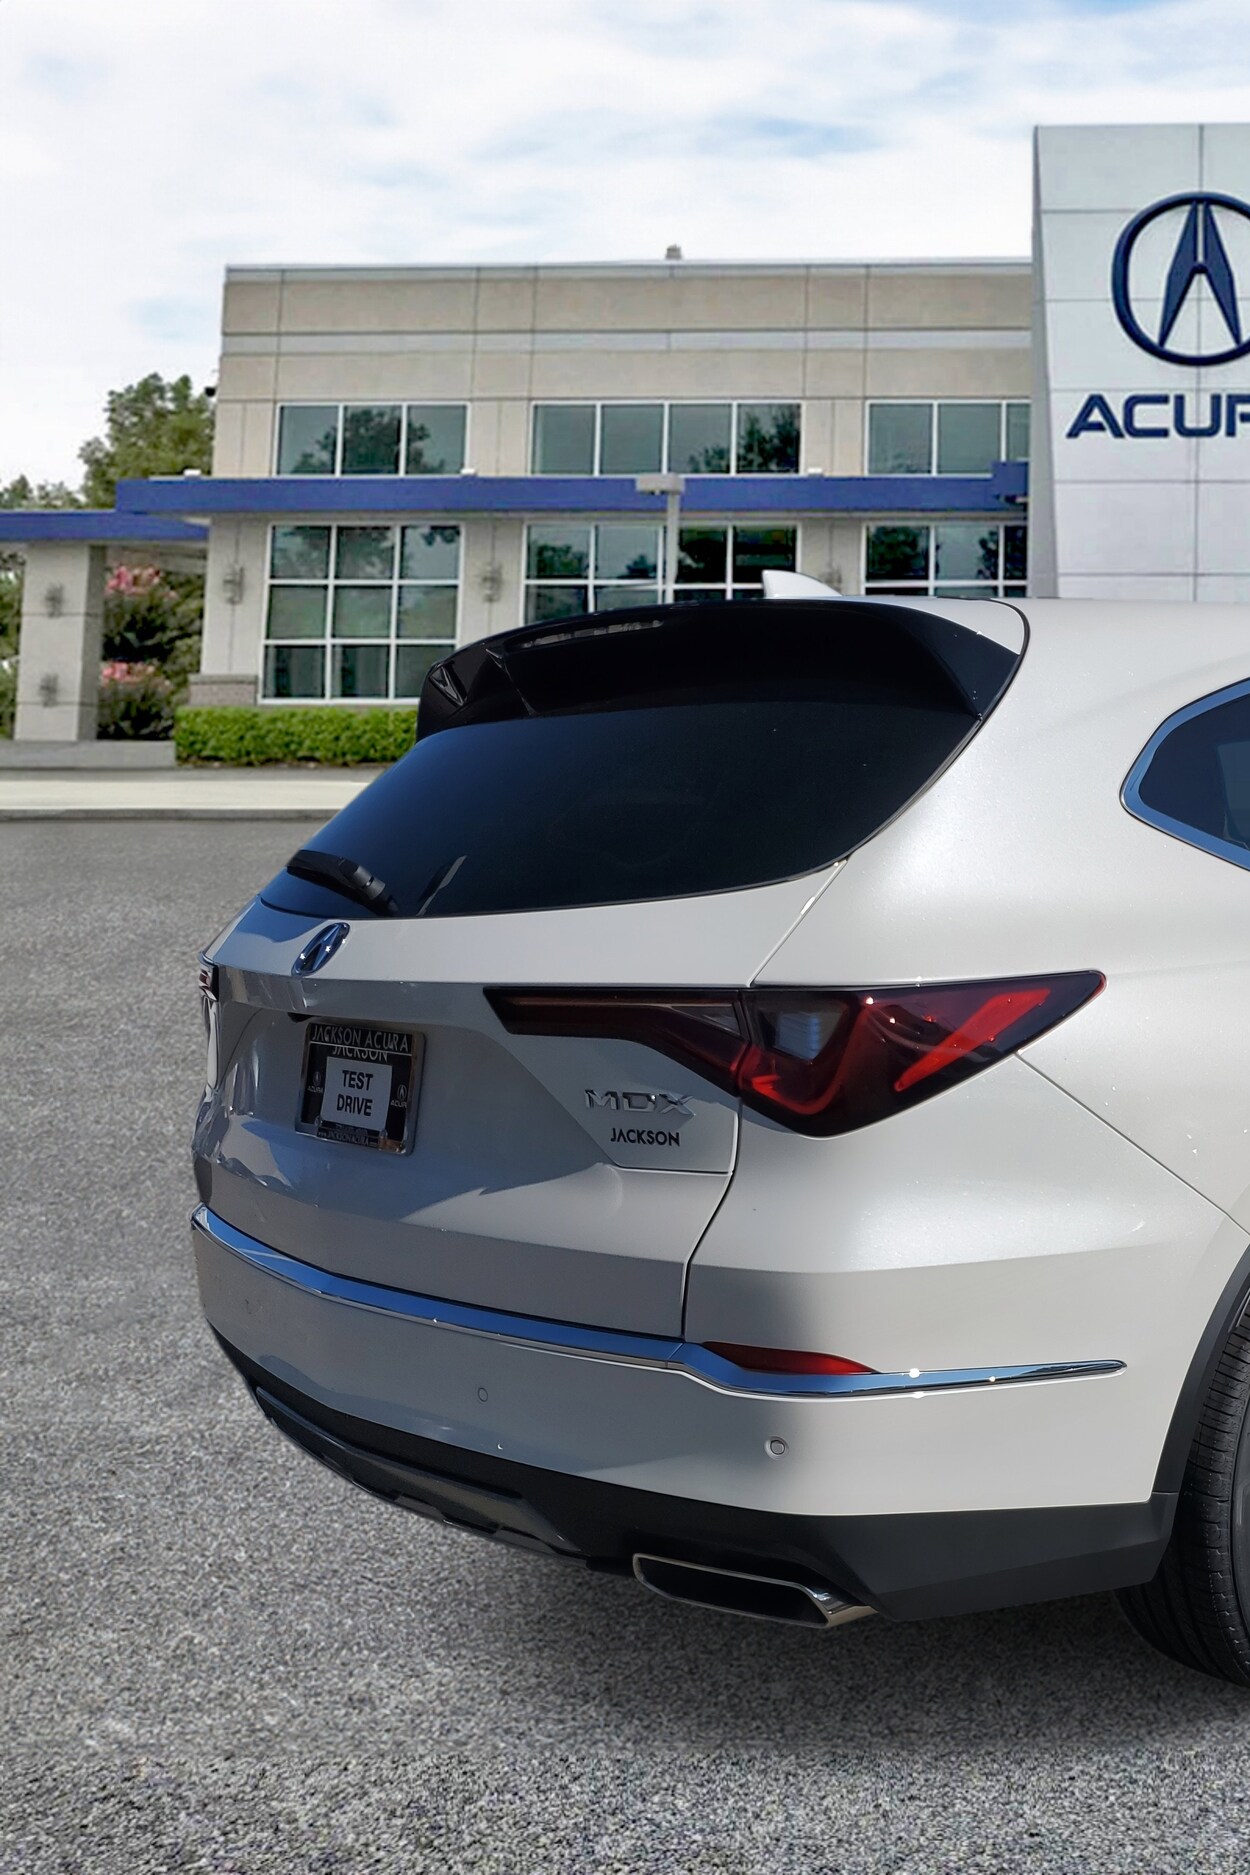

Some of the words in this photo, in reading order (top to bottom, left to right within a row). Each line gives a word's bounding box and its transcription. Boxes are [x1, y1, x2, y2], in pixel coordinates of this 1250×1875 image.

[312, 1025, 361, 1046] JACKSON
[364, 1031, 409, 1052] ACURA
[342, 1069, 374, 1091] TEST
[336, 1093, 373, 1117] DRIVE
[584, 1089, 697, 1116] MDX
[610, 1127, 680, 1147] JACKSON
